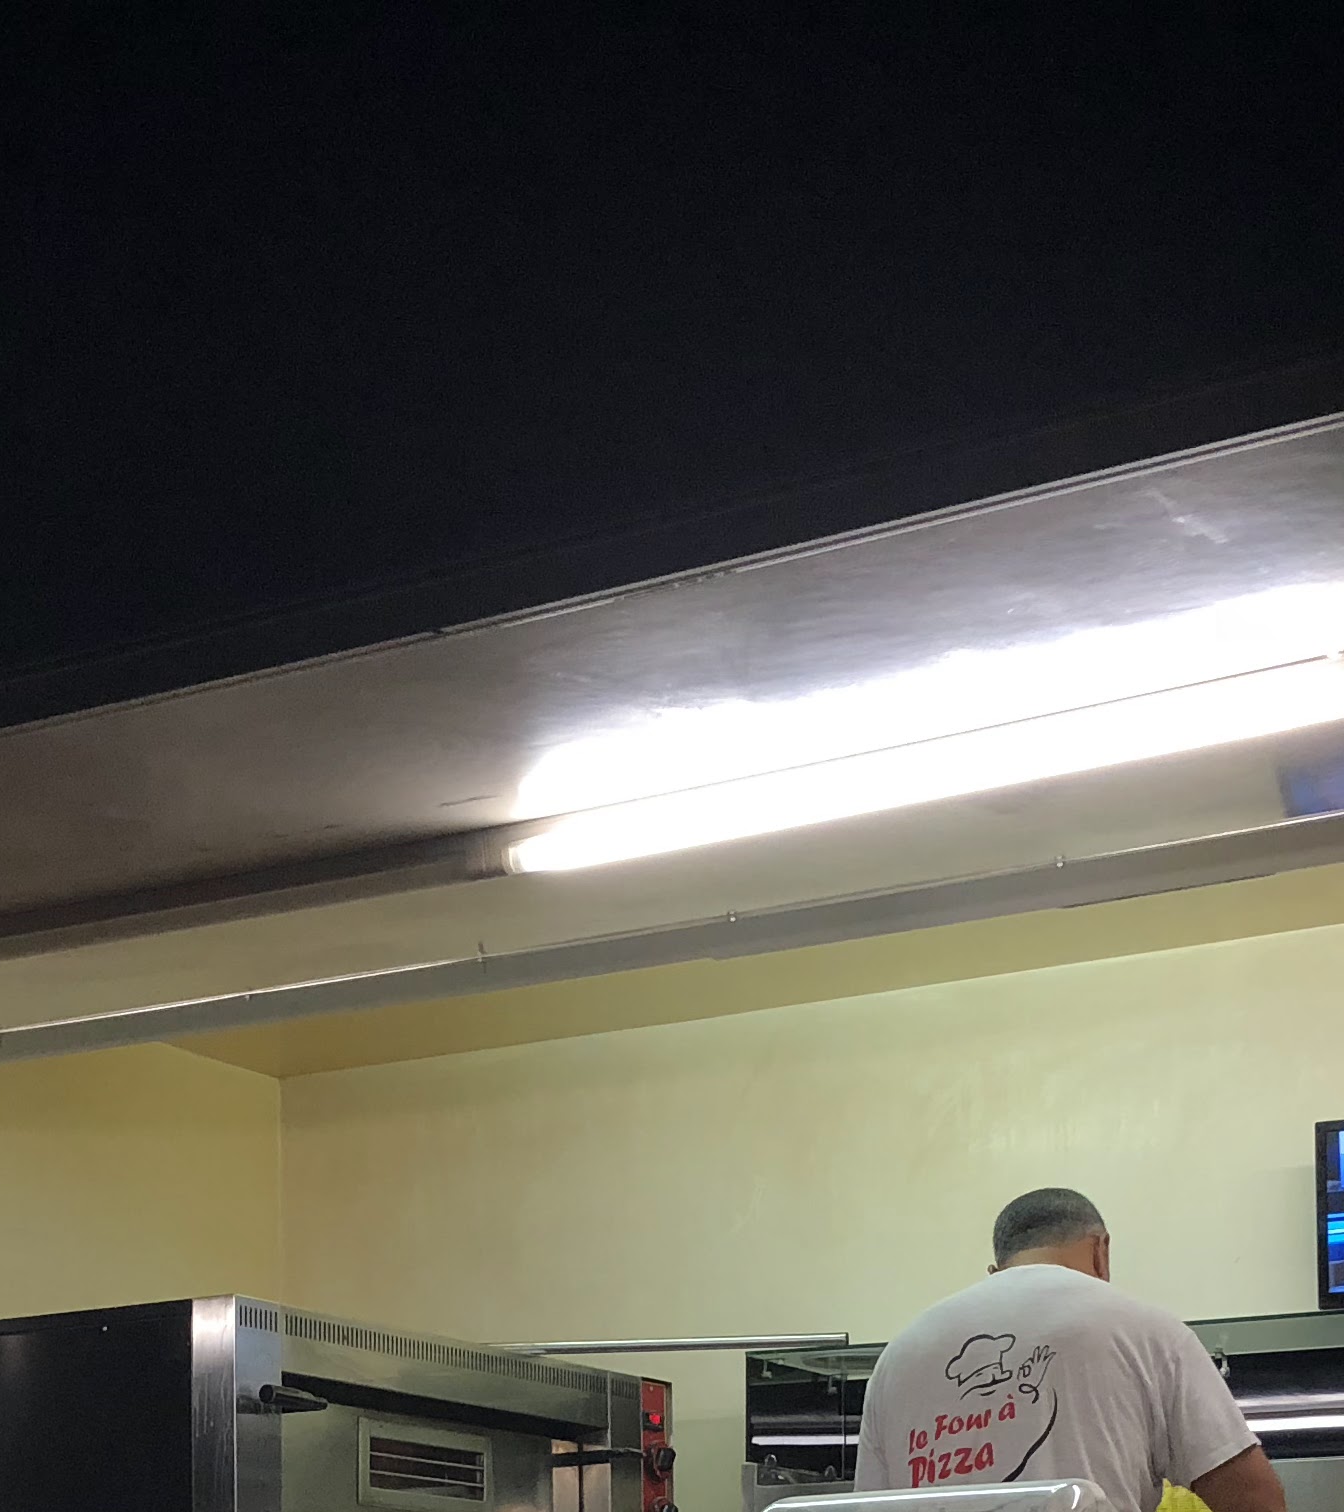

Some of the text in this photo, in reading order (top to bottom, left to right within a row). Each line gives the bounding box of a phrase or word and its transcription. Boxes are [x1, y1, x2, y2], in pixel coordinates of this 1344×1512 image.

[935, 1409, 991, 1440] Four
[998, 1394, 1016, 1421] à
[908, 1443, 994, 1488] Pizza
